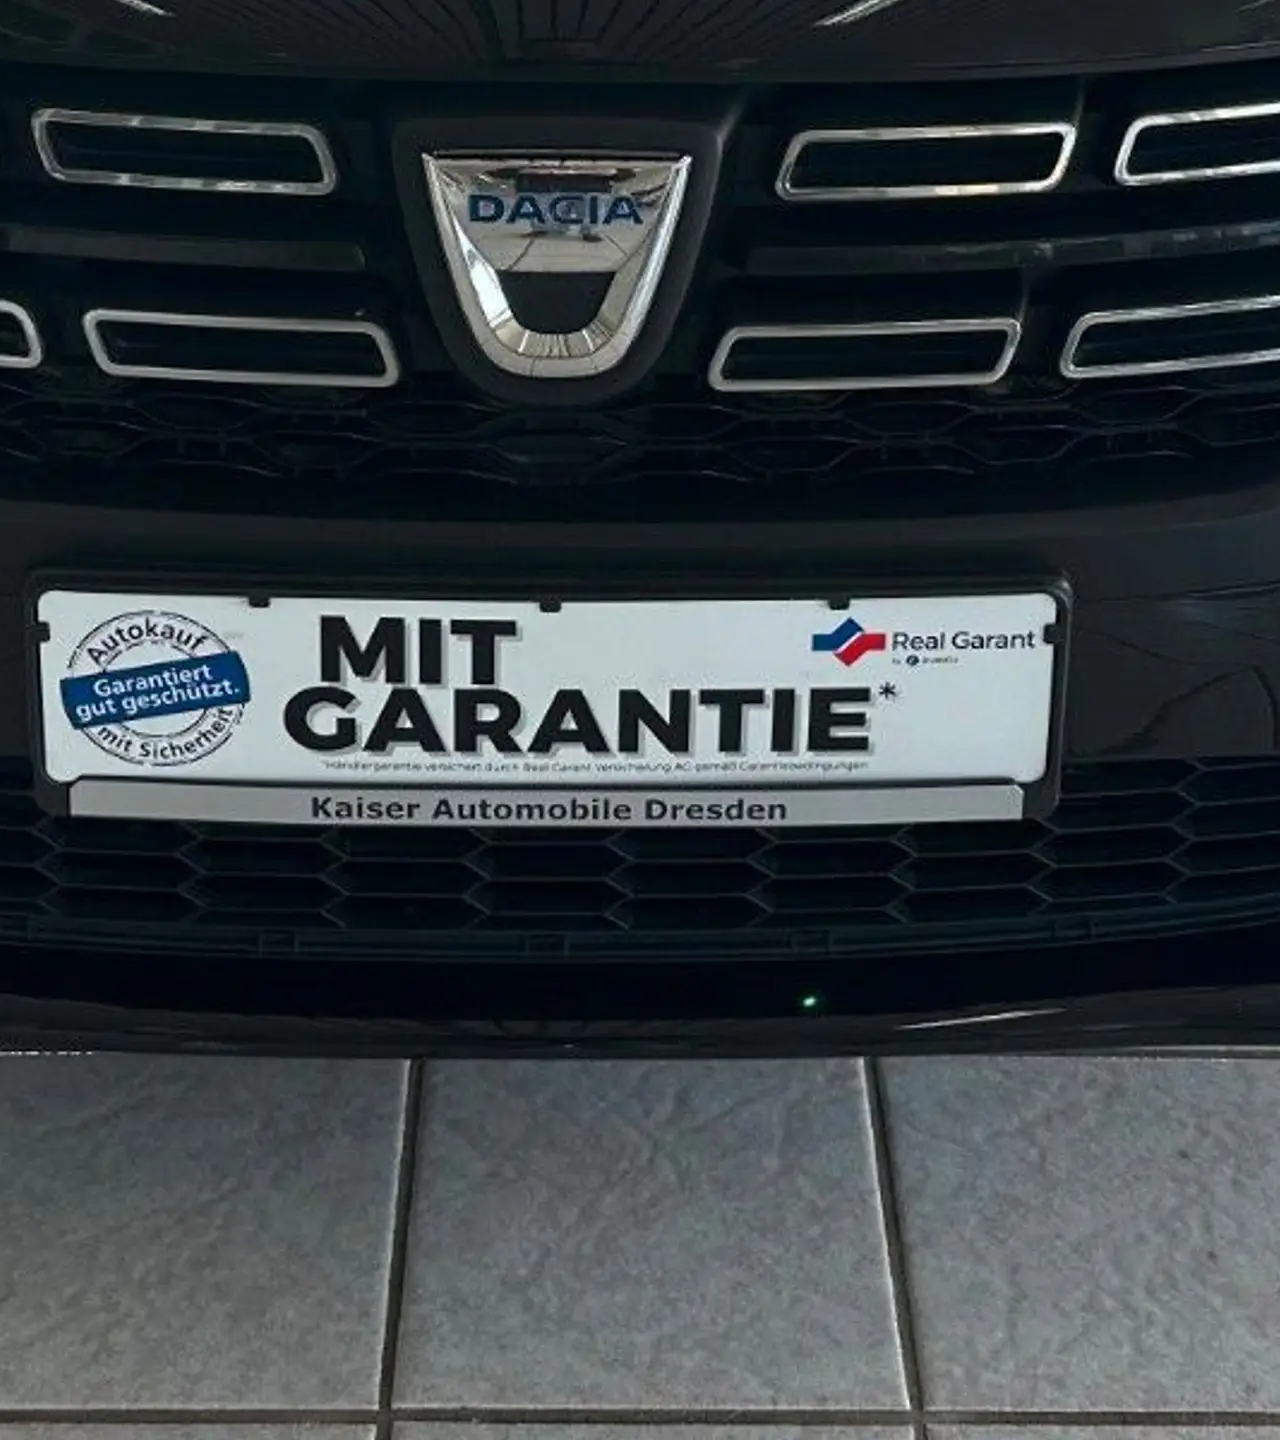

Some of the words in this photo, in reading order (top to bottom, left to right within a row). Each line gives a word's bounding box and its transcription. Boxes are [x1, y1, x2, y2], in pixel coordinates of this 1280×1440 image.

[468, 193, 644, 226] DACIA
[87, 616, 210, 666] Autokauf
[319, 615, 518, 685] MIT
[892, 631, 946, 651] Real
[951, 630, 1036, 651] Garant
[92, 664, 214, 697] Garantiert
[75, 697, 118, 722] gut
[121, 679, 240, 714] geschützt.
[97, 726, 134, 753] mit
[139, 707, 234, 760] Sicherheit
[310, 795, 422, 821] Kaiser
[431, 796, 632, 821] Automobile
[643, 796, 789, 821] Dresden
